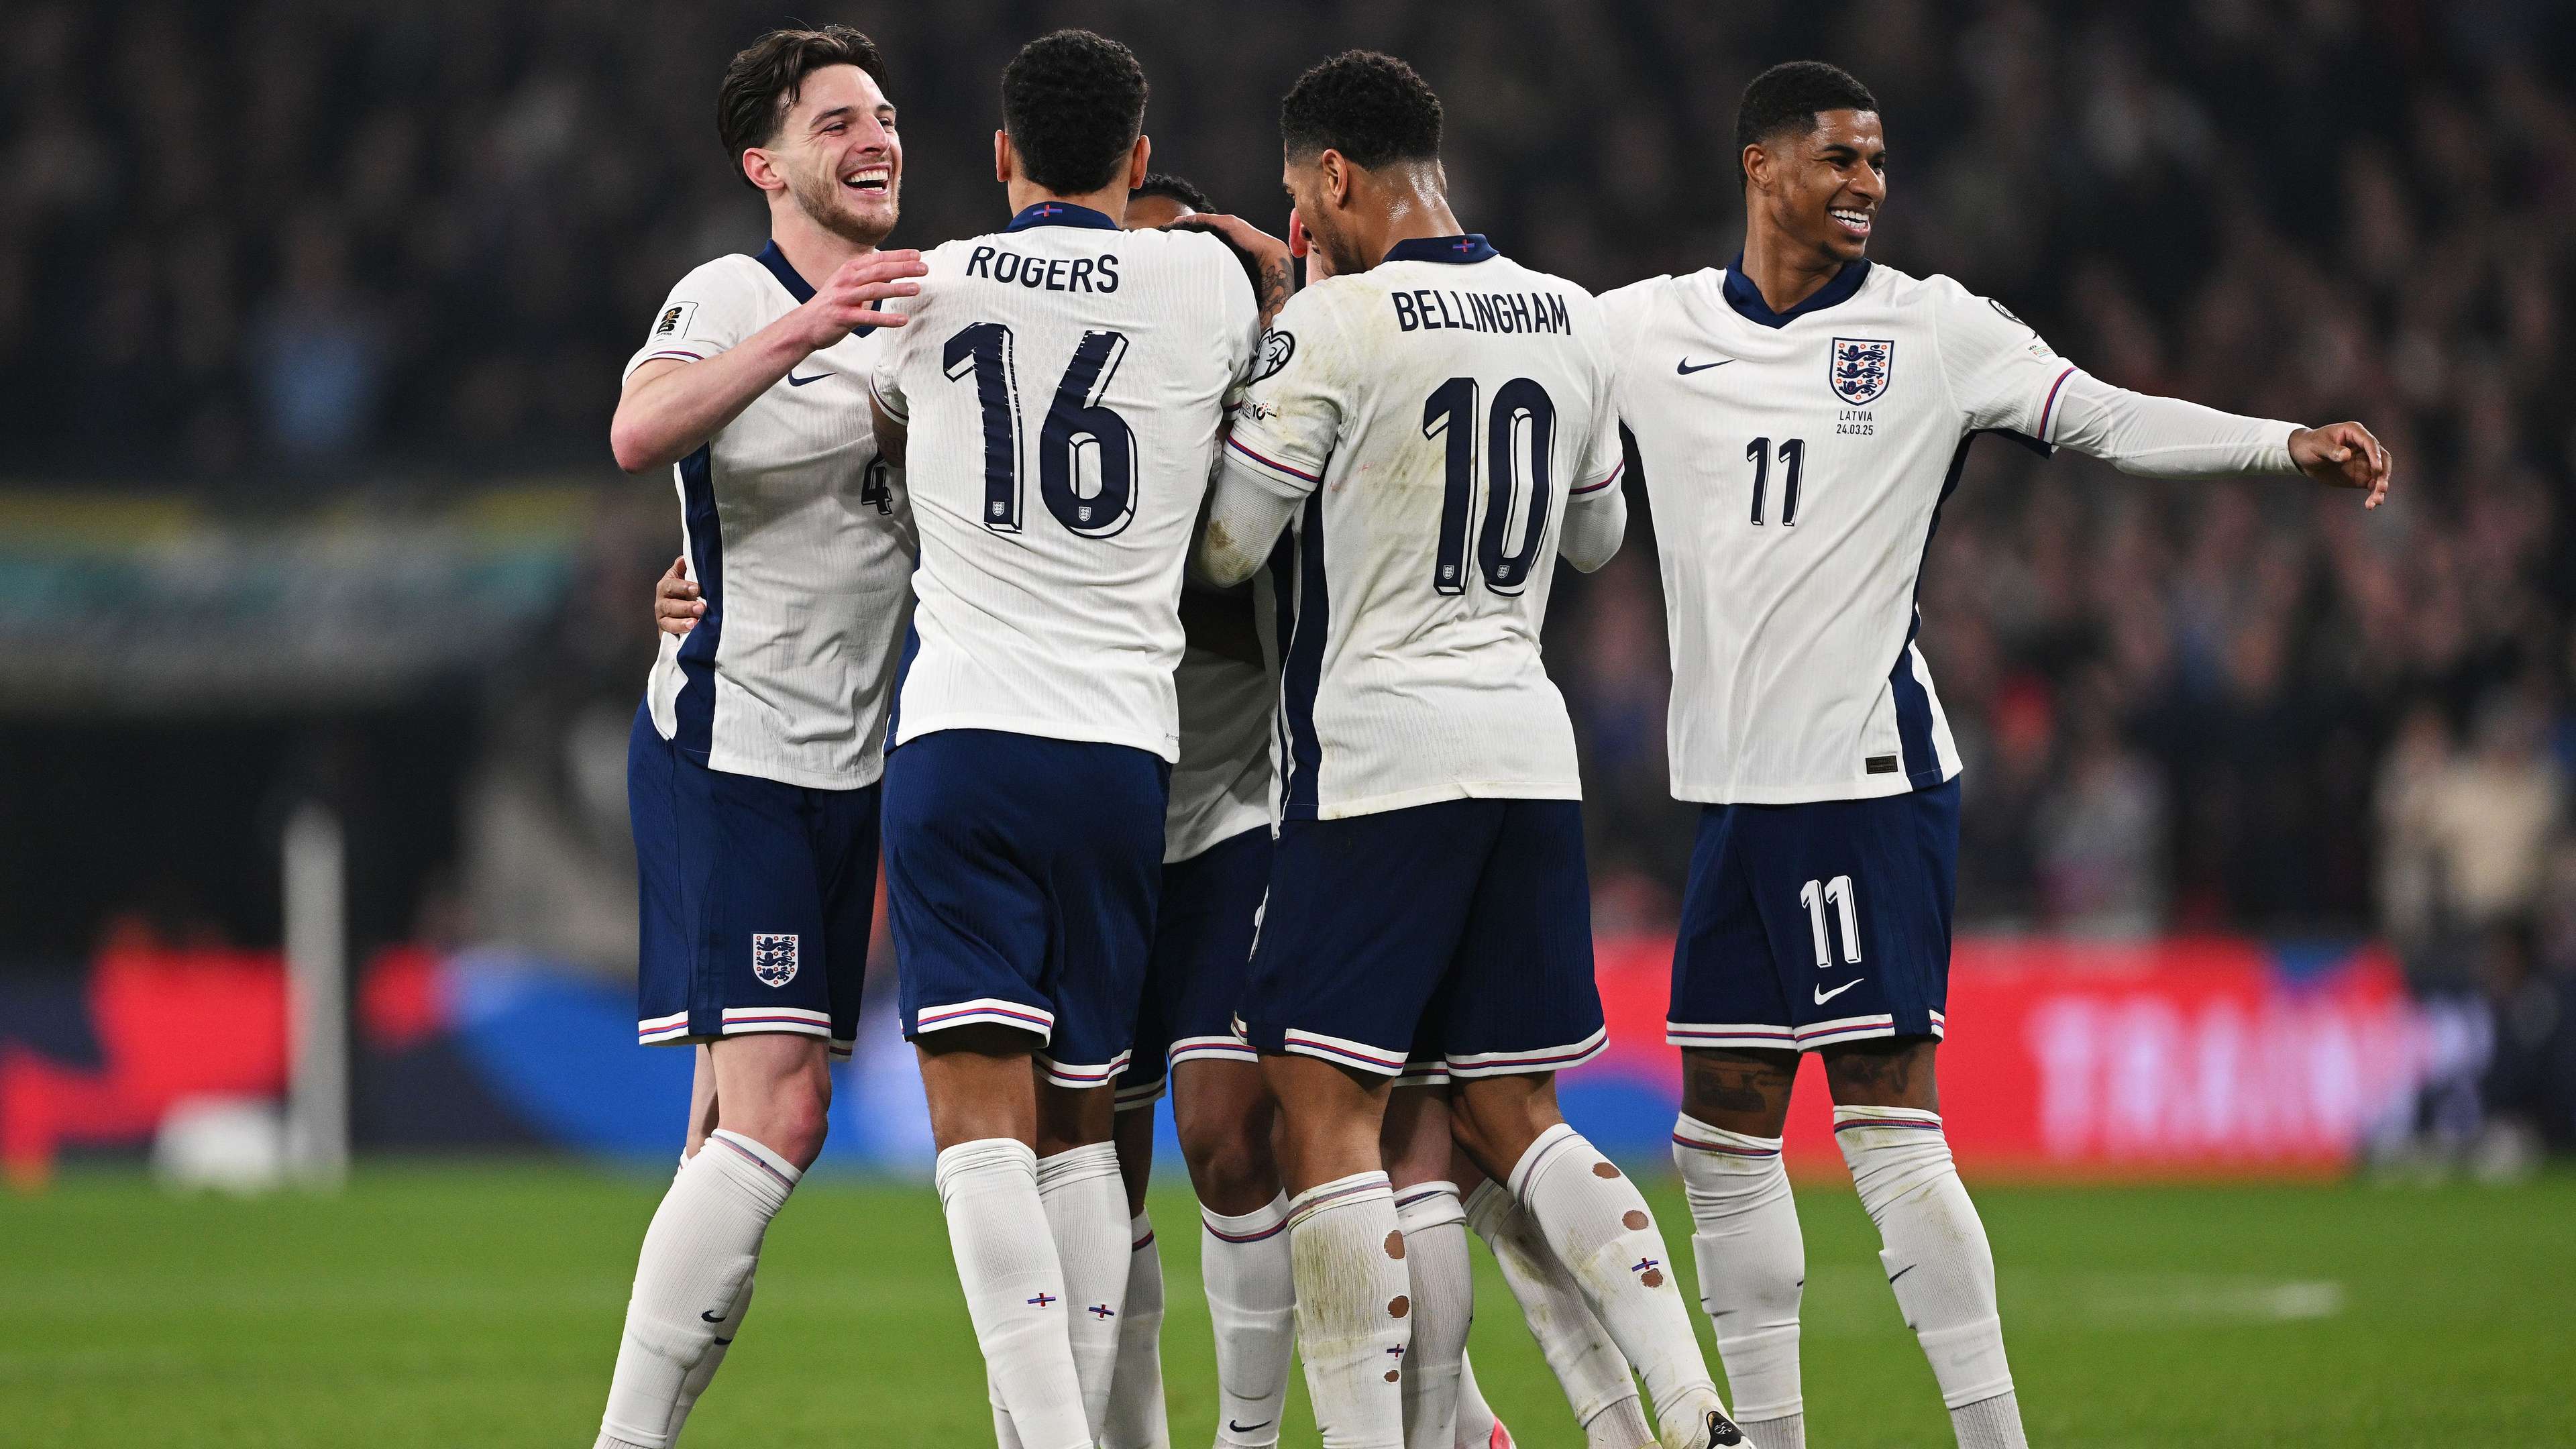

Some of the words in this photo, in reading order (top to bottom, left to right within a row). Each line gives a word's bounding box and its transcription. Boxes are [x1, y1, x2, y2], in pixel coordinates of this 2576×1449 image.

[965, 246, 1119, 294] ROGERS
[1391, 290, 1571, 335] BELLINGHAM
[943, 322, 1138, 539] 16
[1836, 424, 1874, 435] 24.03.25
[1839, 410, 1872, 421] LATVIA
[861, 445, 893, 515] 4
[1423, 377, 1557, 596] 10
[1746, 437, 1805, 527] 11
[1800, 875, 1862, 968] 11
